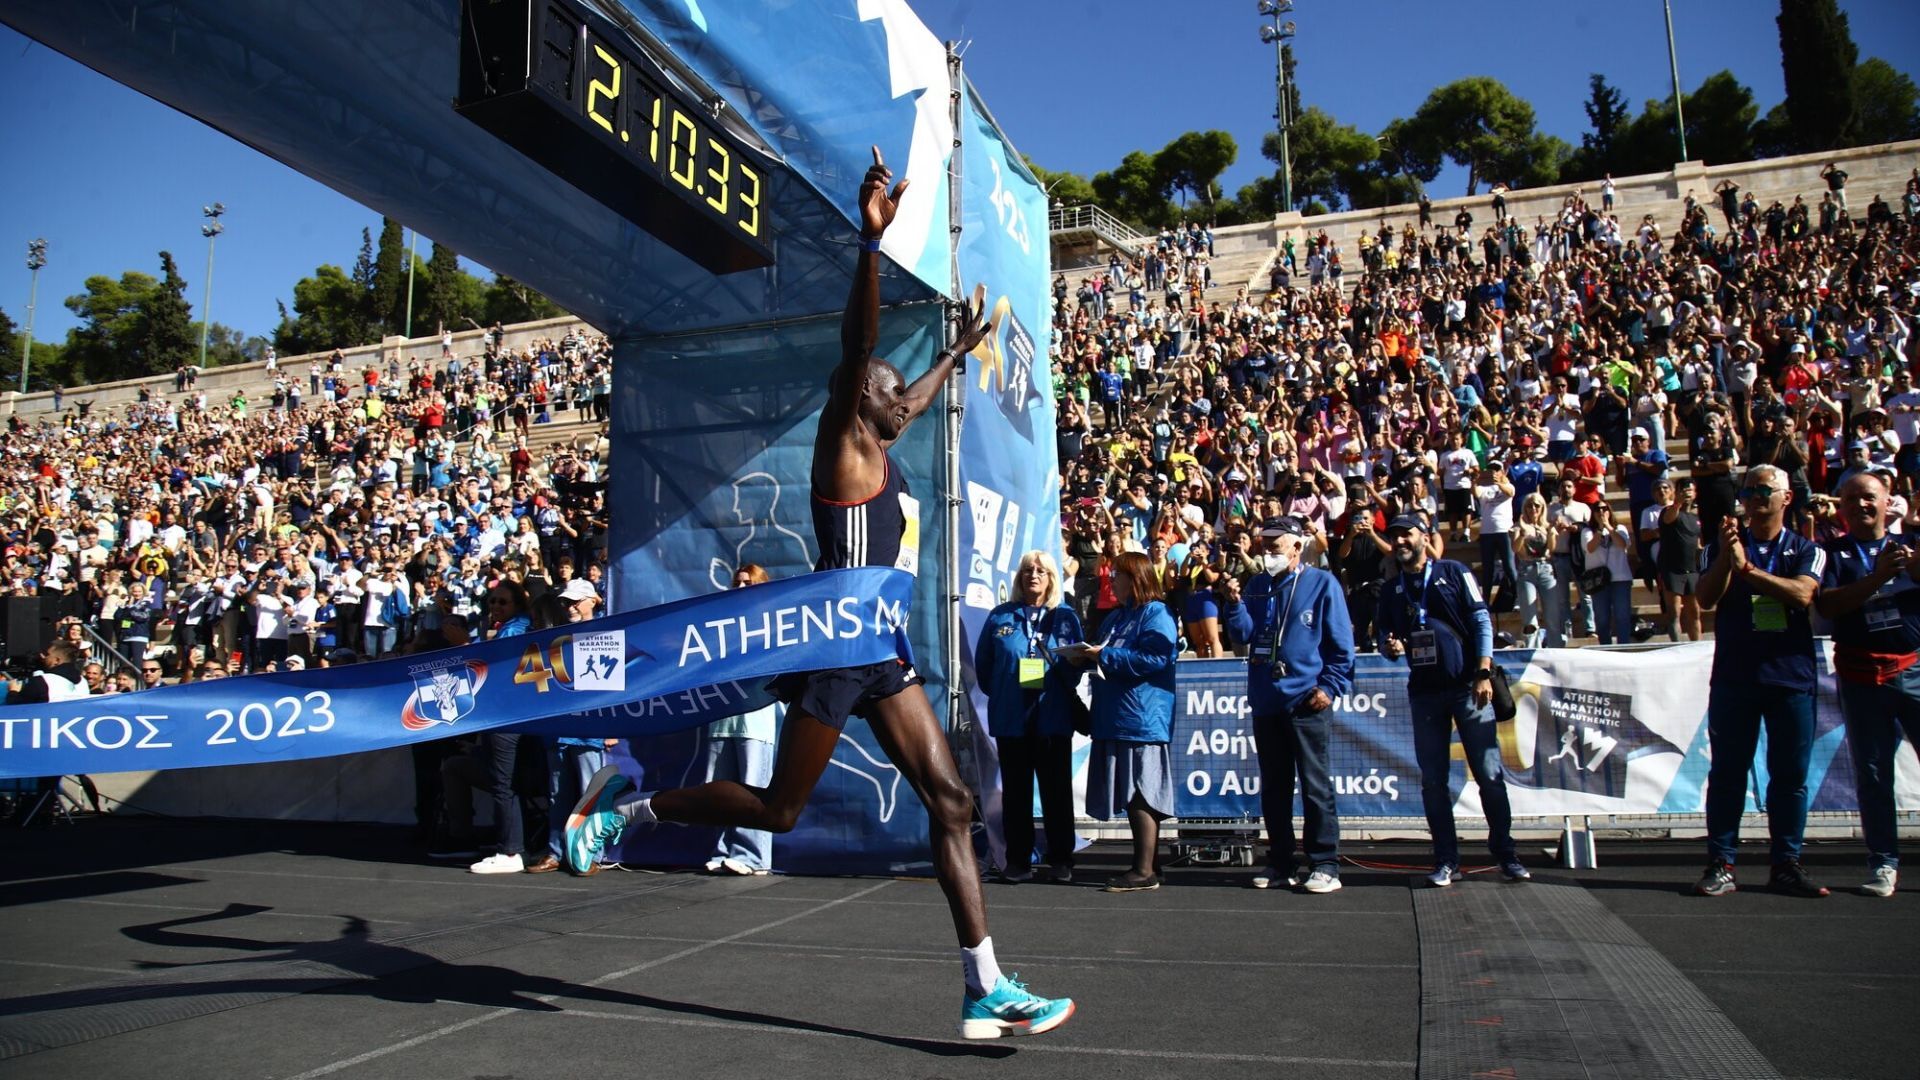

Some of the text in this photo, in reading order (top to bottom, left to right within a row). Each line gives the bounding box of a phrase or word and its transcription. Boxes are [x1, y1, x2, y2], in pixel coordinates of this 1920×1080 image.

[587, 44, 760, 237] 2.10.33
[678, 597, 863, 667] ATHENS
[1550, 700, 1622, 718] MARATHON
[1563, 691, 1611, 706] ATHENS
[205, 691, 336, 746] 2023
[1550, 710, 1621, 728] THE AUTHENTIC
[1187, 770, 1212, 797] Ο
